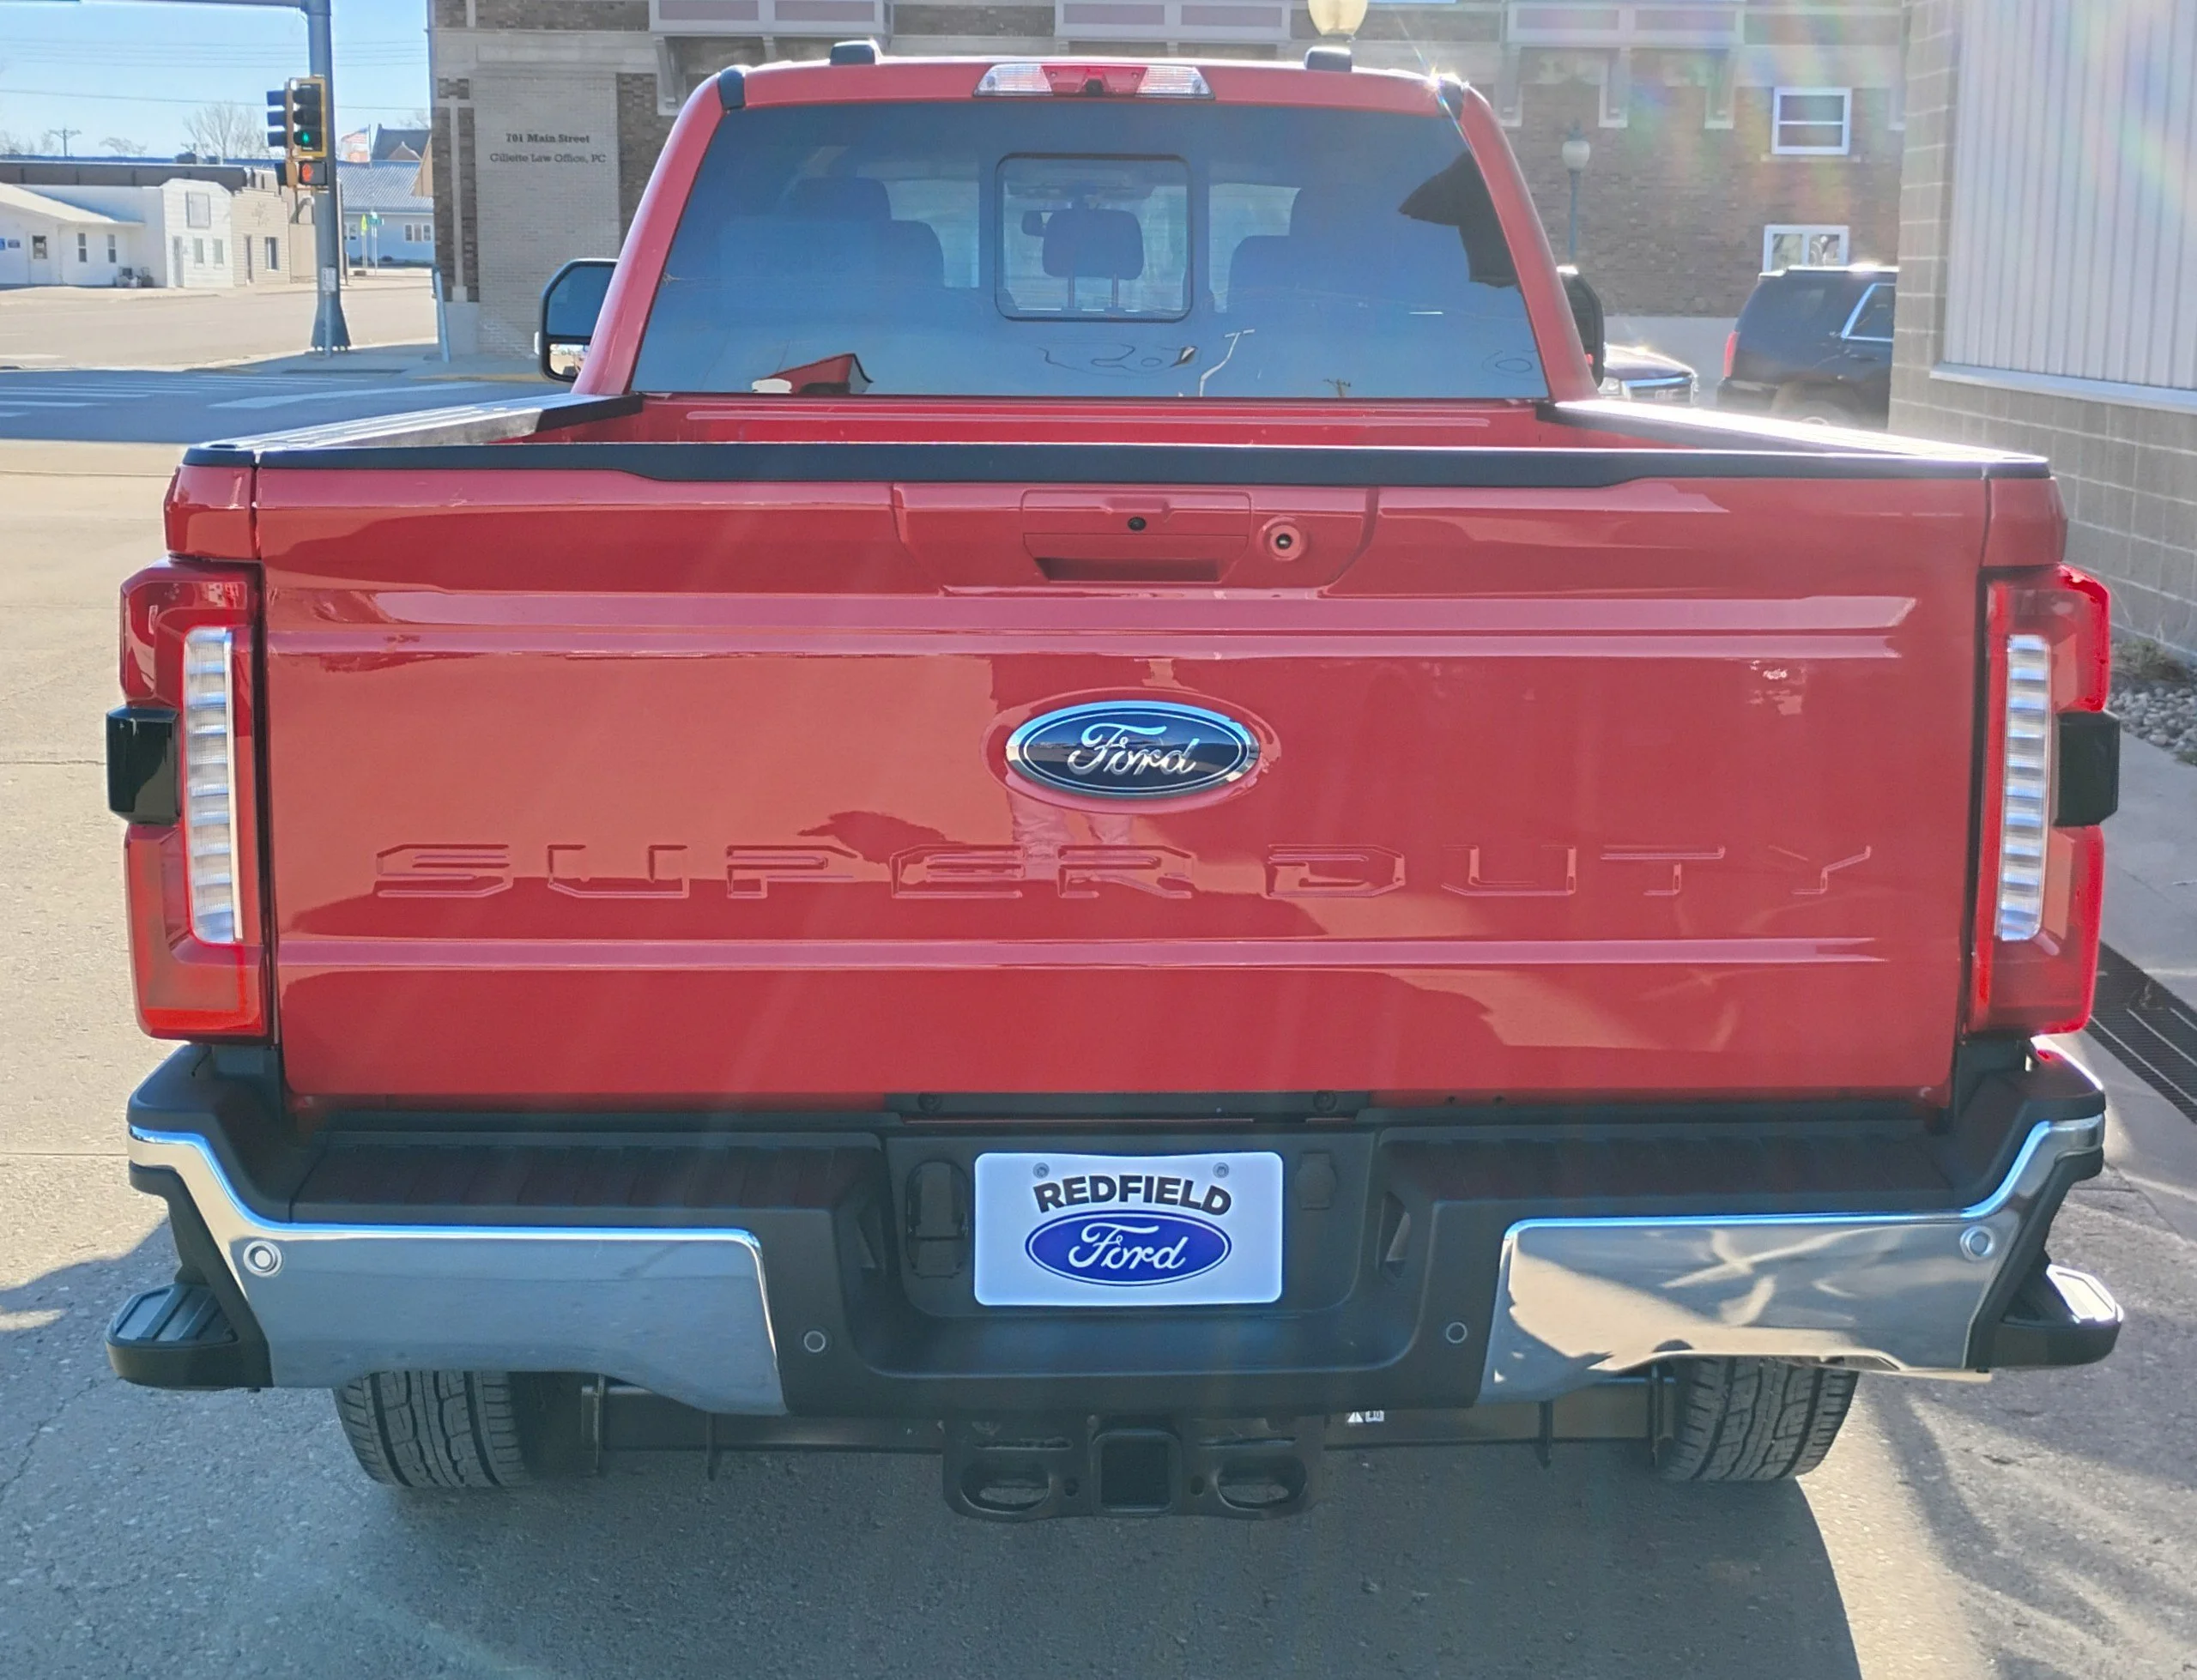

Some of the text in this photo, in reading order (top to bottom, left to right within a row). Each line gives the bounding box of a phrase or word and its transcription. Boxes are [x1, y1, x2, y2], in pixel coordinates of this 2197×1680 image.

[489, 154, 607, 164] Gillette Law Office, PC
[505, 133, 590, 144] 701 Main Street
[1067, 722, 1200, 776] Ford
[376, 843, 1873, 899] SUPER DUTY
[1033, 1175, 1232, 1216] REDFIELD
[1068, 1222, 1189, 1270] Ford
